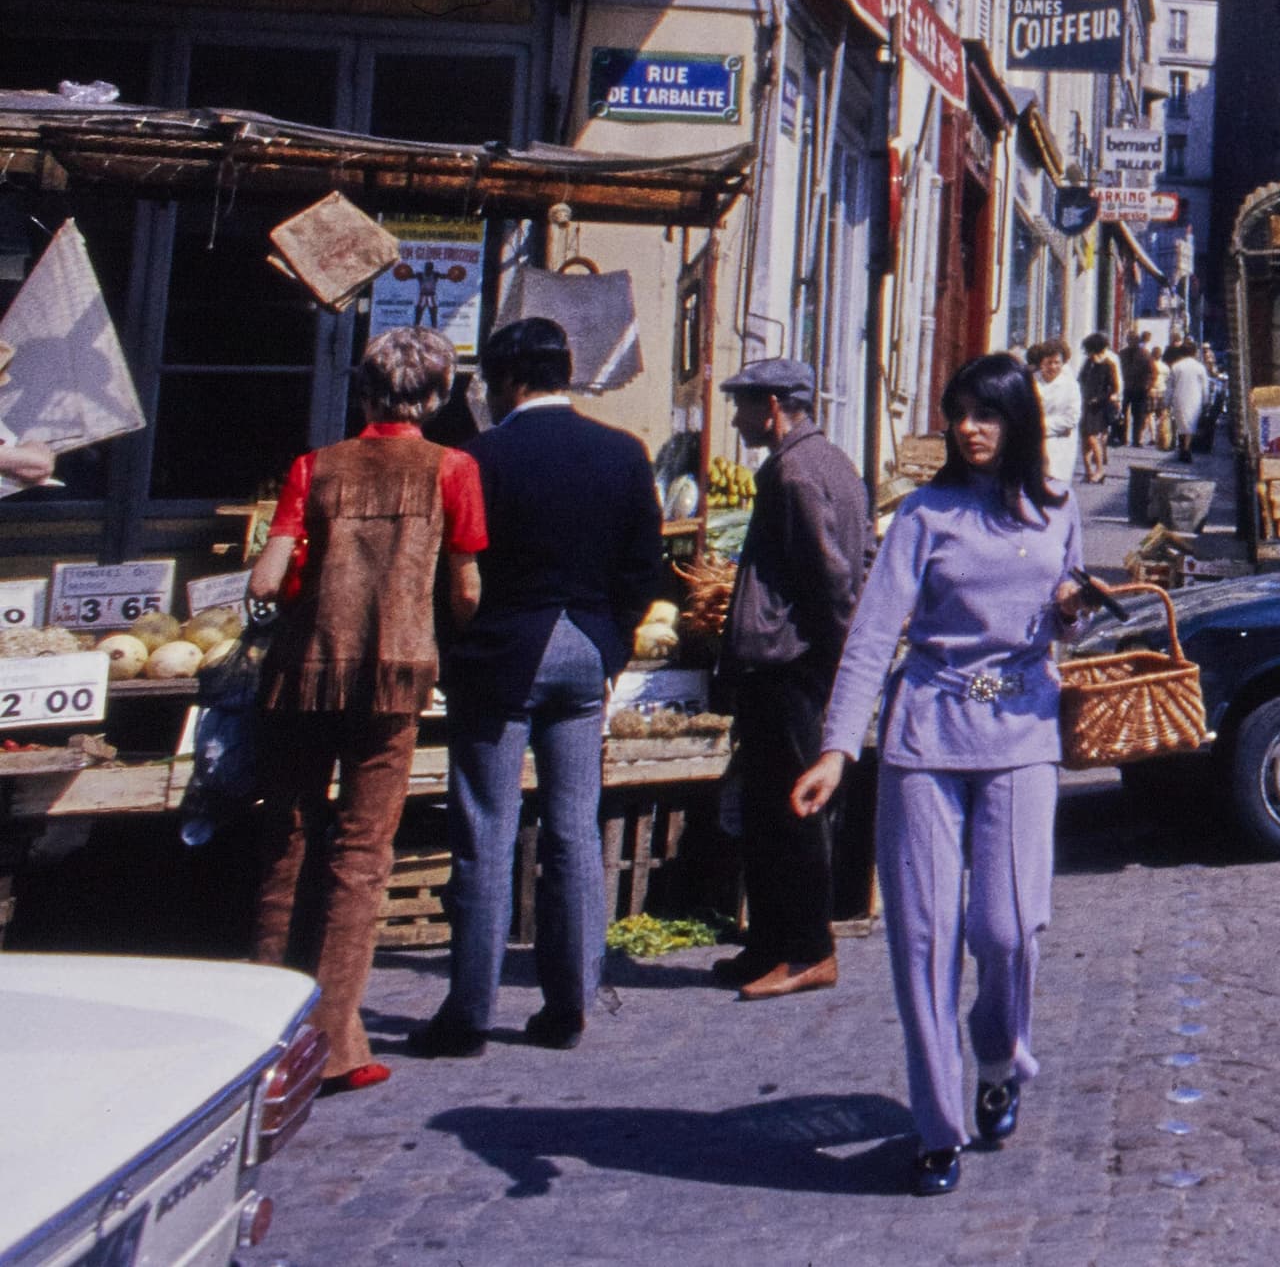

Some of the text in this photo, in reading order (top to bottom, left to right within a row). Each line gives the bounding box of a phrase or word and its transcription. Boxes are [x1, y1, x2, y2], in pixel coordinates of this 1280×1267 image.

[1011, 8, 1121, 60] COIFFEUR
[646, 65, 689, 84] RUE
[608, 85, 630, 104] DE
[1106, 135, 1163, 153] bernard
[81, 598, 102, 623] 3
[121, 596, 161, 621] 65
[1, 692, 21, 718] 2
[46, 688, 94, 714] 00
